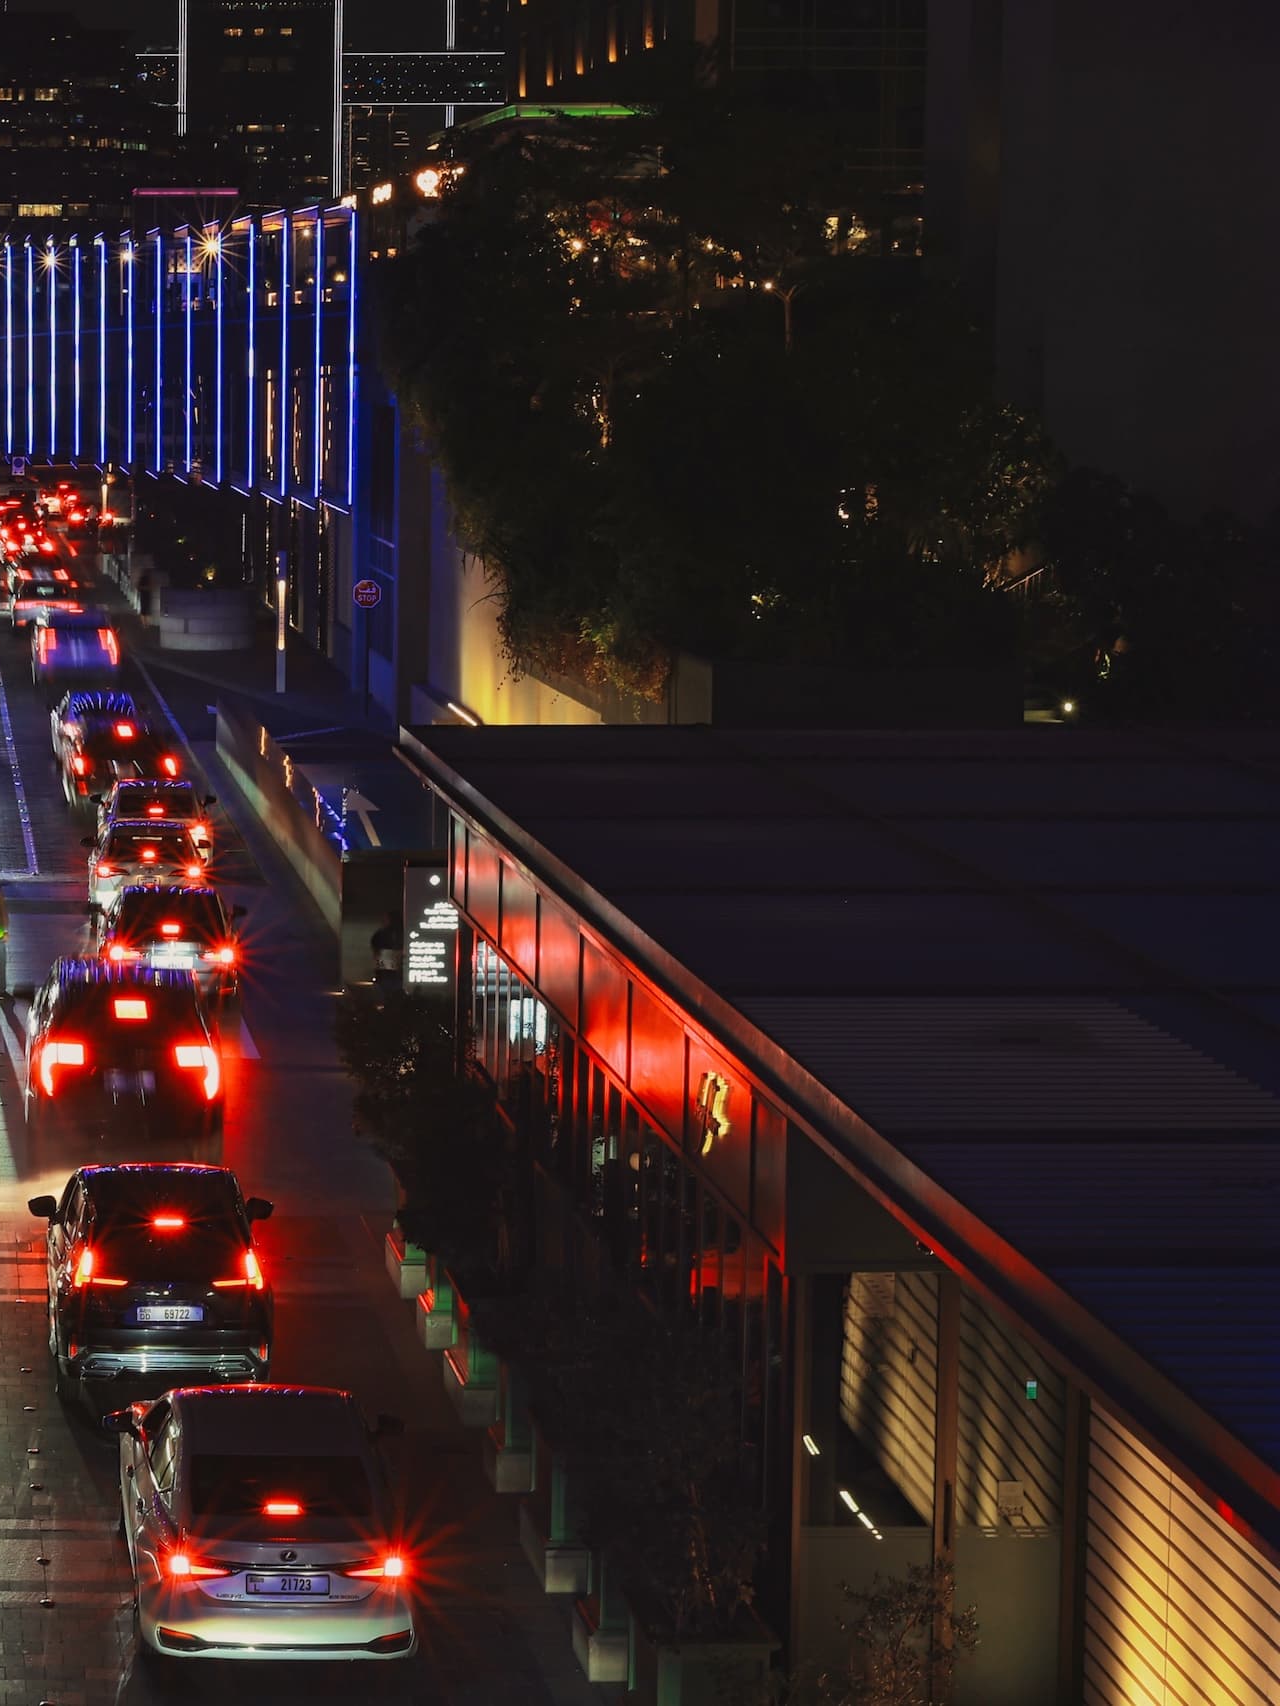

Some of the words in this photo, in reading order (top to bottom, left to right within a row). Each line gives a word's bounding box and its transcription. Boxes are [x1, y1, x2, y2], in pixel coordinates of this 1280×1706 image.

[357, 594, 377, 602] STOP
[164, 1309, 190, 1320] 69722
[253, 1583, 261, 1592] L
[281, 1578, 312, 1591] 21723
